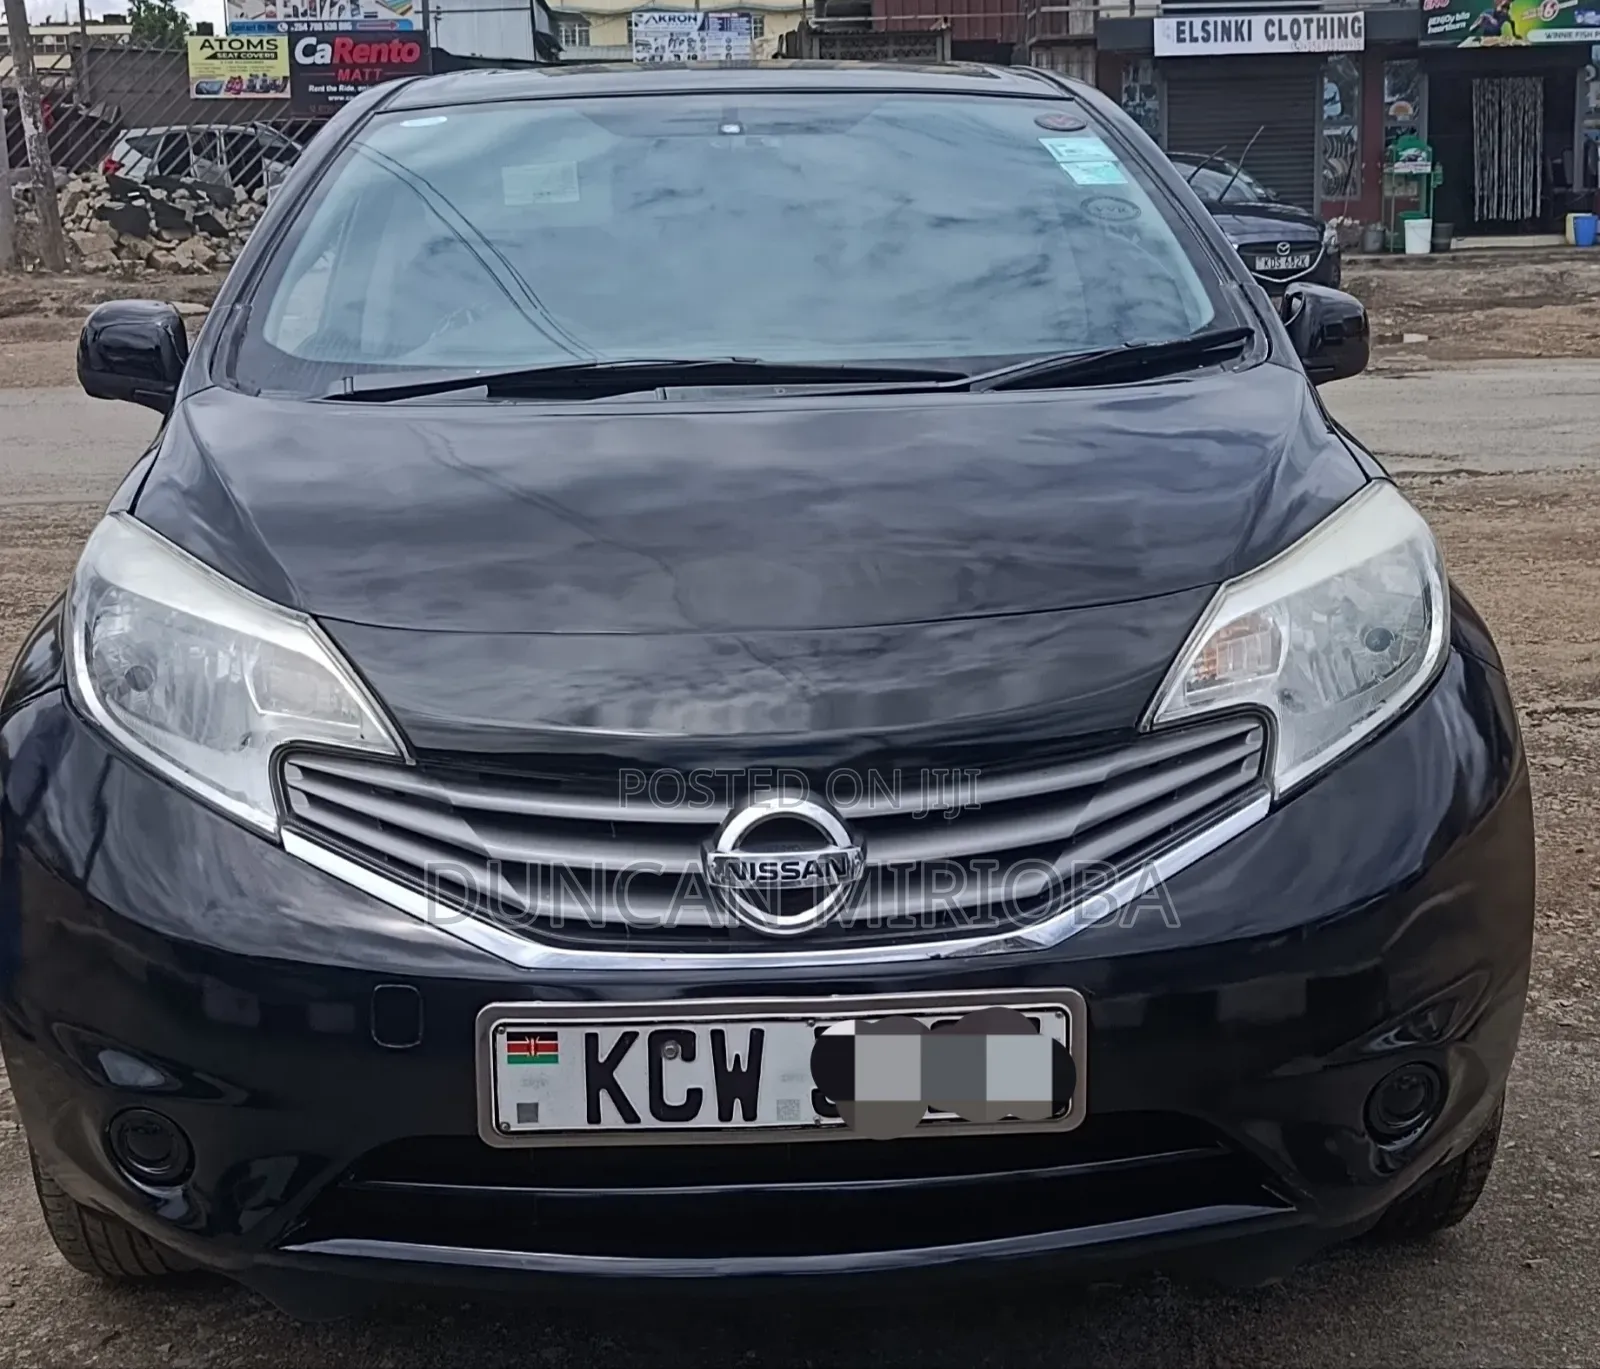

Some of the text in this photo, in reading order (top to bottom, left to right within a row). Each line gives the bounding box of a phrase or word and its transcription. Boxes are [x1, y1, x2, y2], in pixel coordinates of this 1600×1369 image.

[645, 14, 697, 24] AKRON
[1264, 16, 1362, 42] CLOTHING
[200, 38, 278, 50] ATOMS
[294, 36, 421, 65] CaRento
[338, 69, 383, 81] MATT
[308, 84, 325, 92] Rent
[326, 84, 338, 92] the
[1264, 257, 1281, 268] KDS
[727, 856, 848, 881] NISSAN
[584, 1028, 765, 1125] KCW
